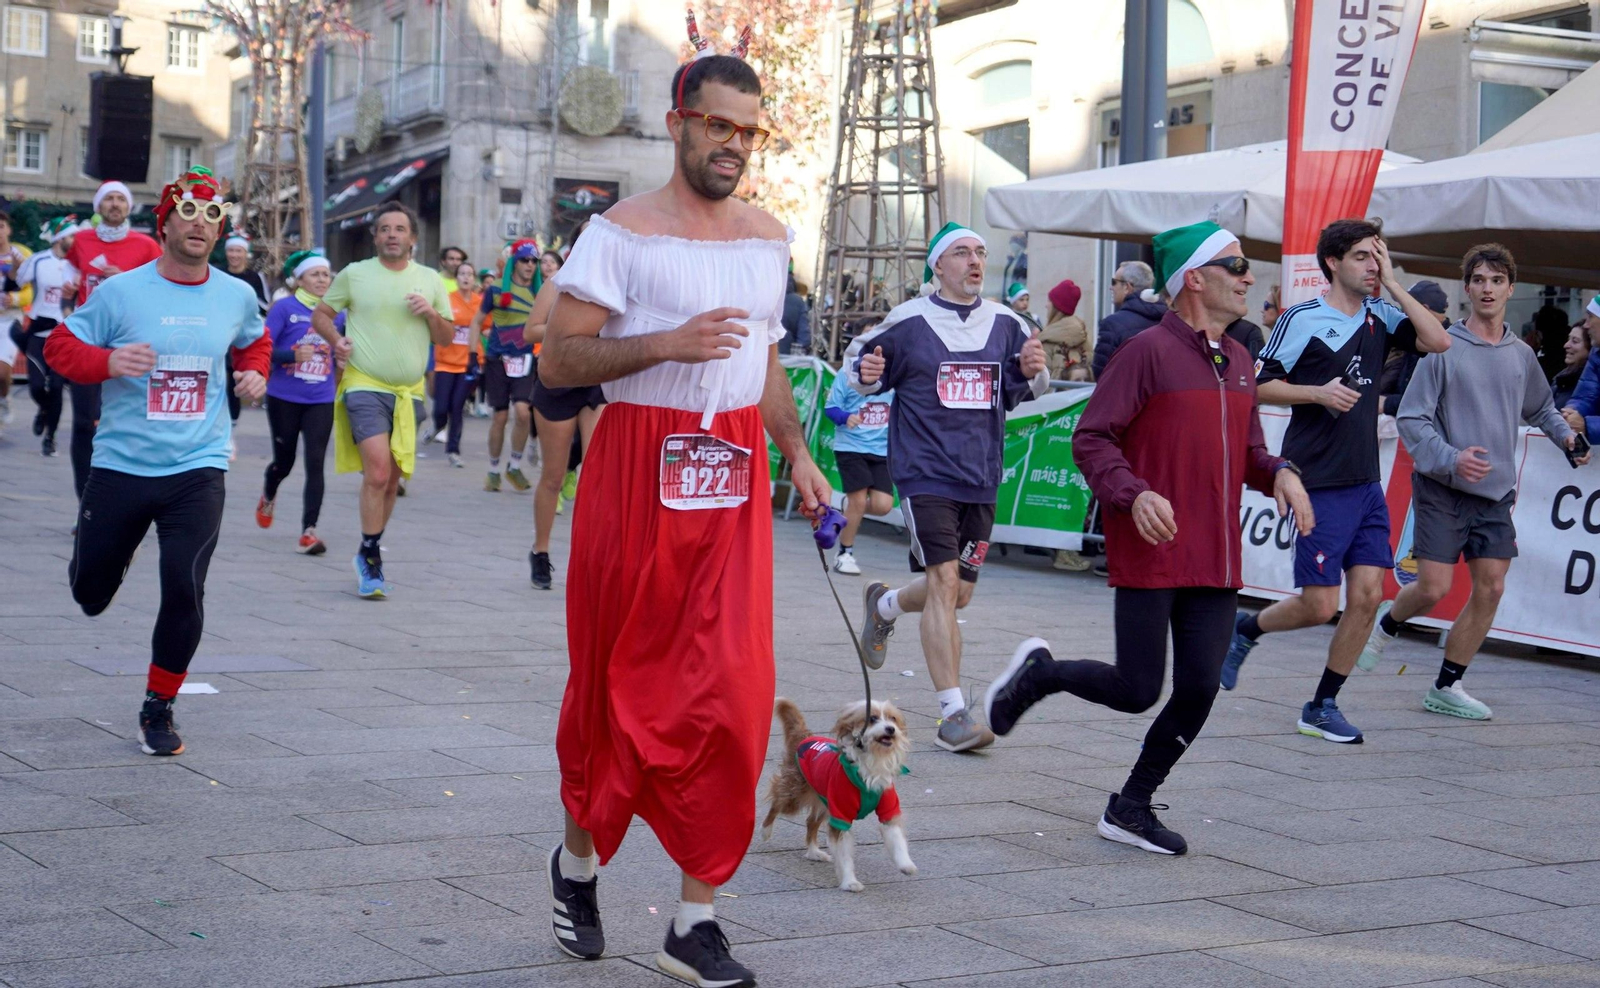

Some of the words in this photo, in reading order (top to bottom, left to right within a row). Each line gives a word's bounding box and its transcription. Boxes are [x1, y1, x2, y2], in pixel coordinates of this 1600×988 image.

[167, 379, 198, 391] vigo
[954, 371, 981, 382] vigo
[946, 382, 985, 401] 1748
[160, 391, 199, 412] 1721
[863, 412, 887, 425] 2592
[688, 450, 733, 466] vigo
[681, 466, 730, 496] 922
[1030, 465, 1058, 484] máis
[1069, 472, 1091, 491] aug
[1240, 506, 1291, 551] IGO
